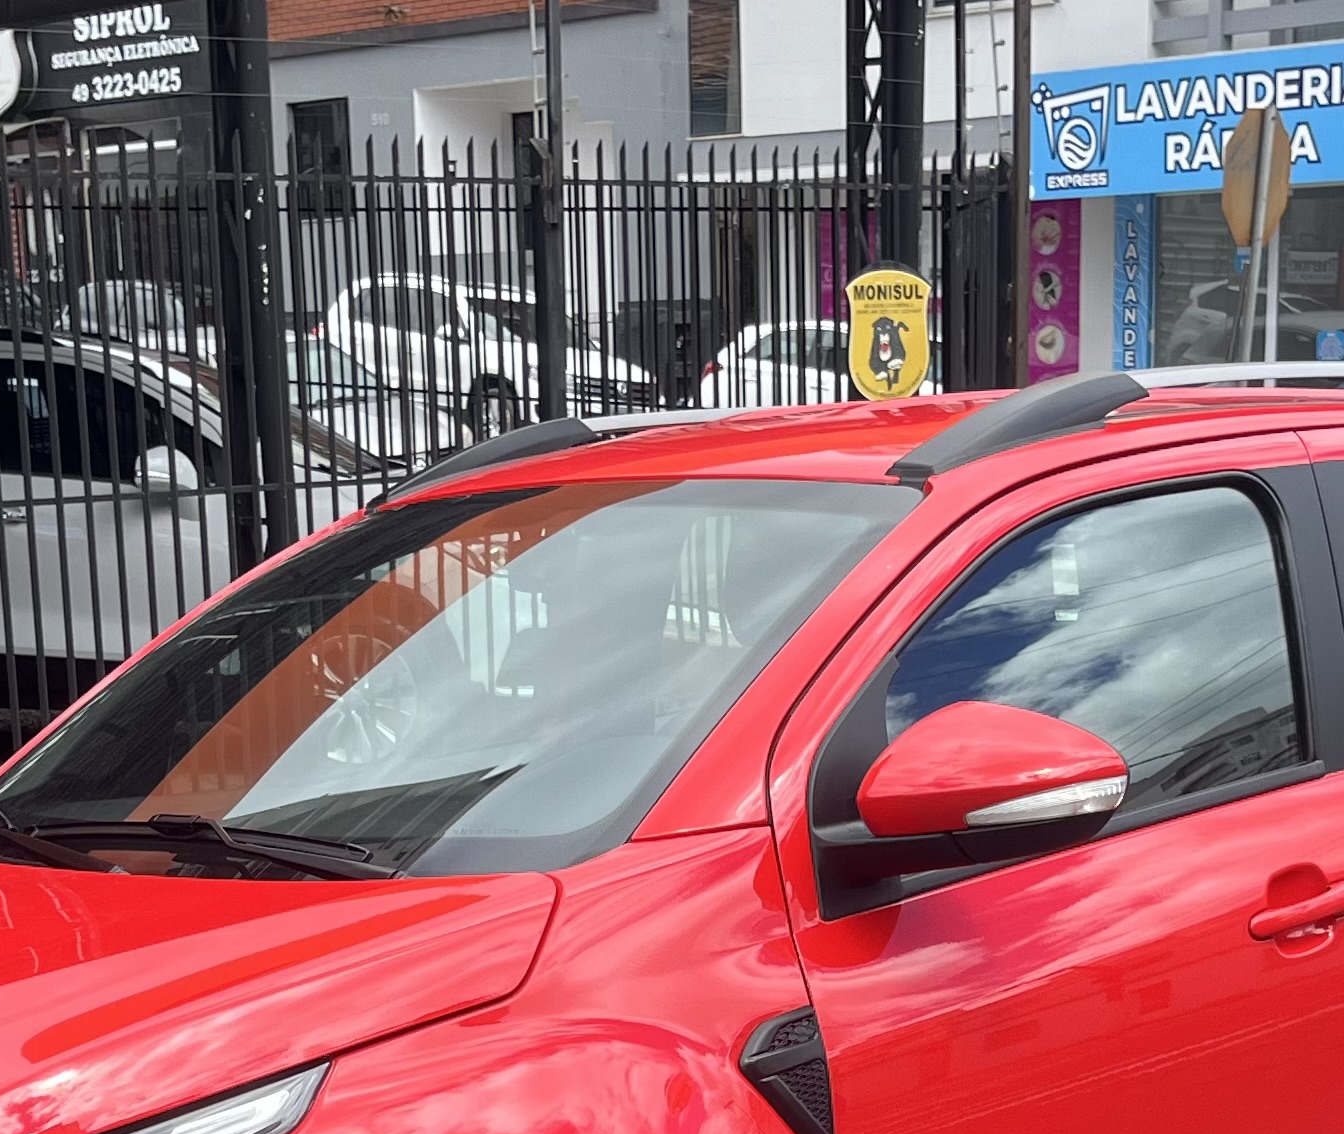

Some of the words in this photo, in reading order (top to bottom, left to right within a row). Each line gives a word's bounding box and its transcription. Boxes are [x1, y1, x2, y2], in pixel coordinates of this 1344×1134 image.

[73, 4, 171, 42] SIPROL
[51, 45, 123, 69] SEGURANÇA
[123, 34, 200, 60] ELETRÔNICA
[92, 66, 182, 101] 3223-0425
[1166, 121, 1320, 172] RÁA
[1047, 172, 1107, 189] EXPRESS
[853, 284, 923, 300] MONISUL
